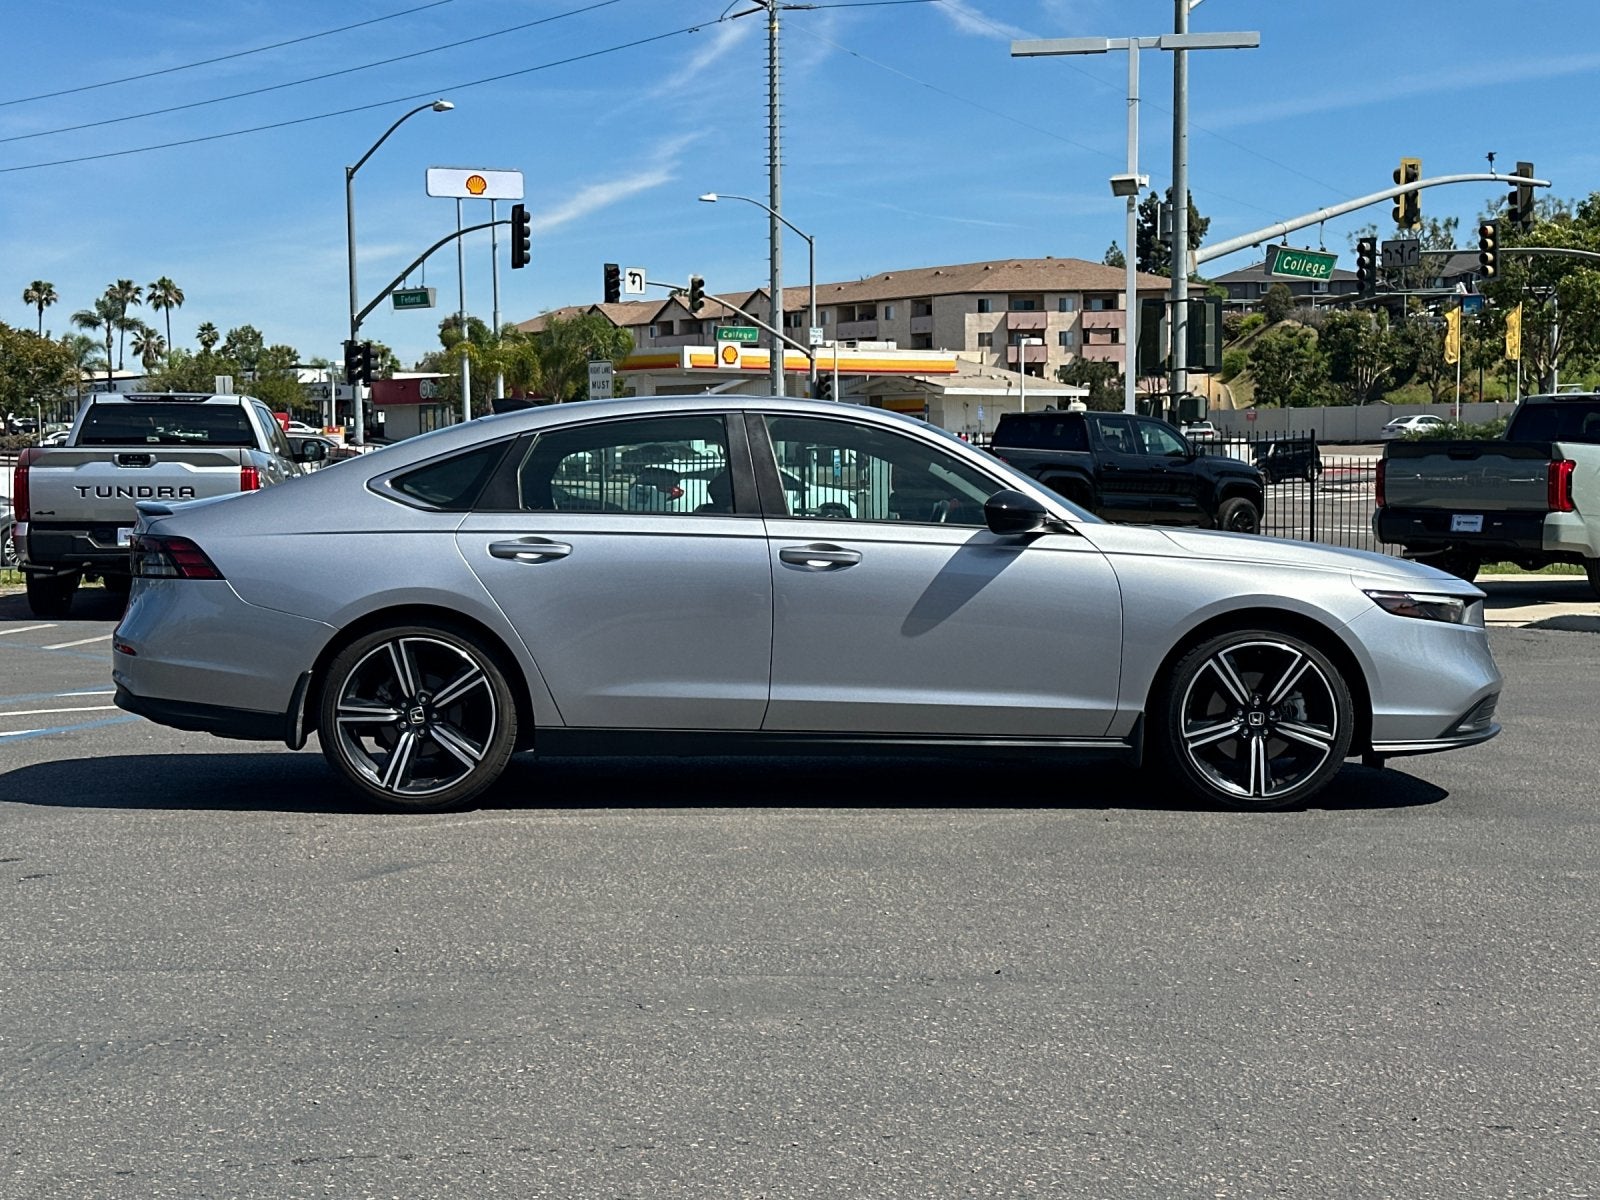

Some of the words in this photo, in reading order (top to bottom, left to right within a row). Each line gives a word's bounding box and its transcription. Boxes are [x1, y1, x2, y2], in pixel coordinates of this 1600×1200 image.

[1283, 256, 1325, 276] College
[400, 295, 421, 304] Federal
[723, 330, 752, 340] College
[592, 380, 609, 389] MUST
[74, 485, 195, 499] TUNDRA
